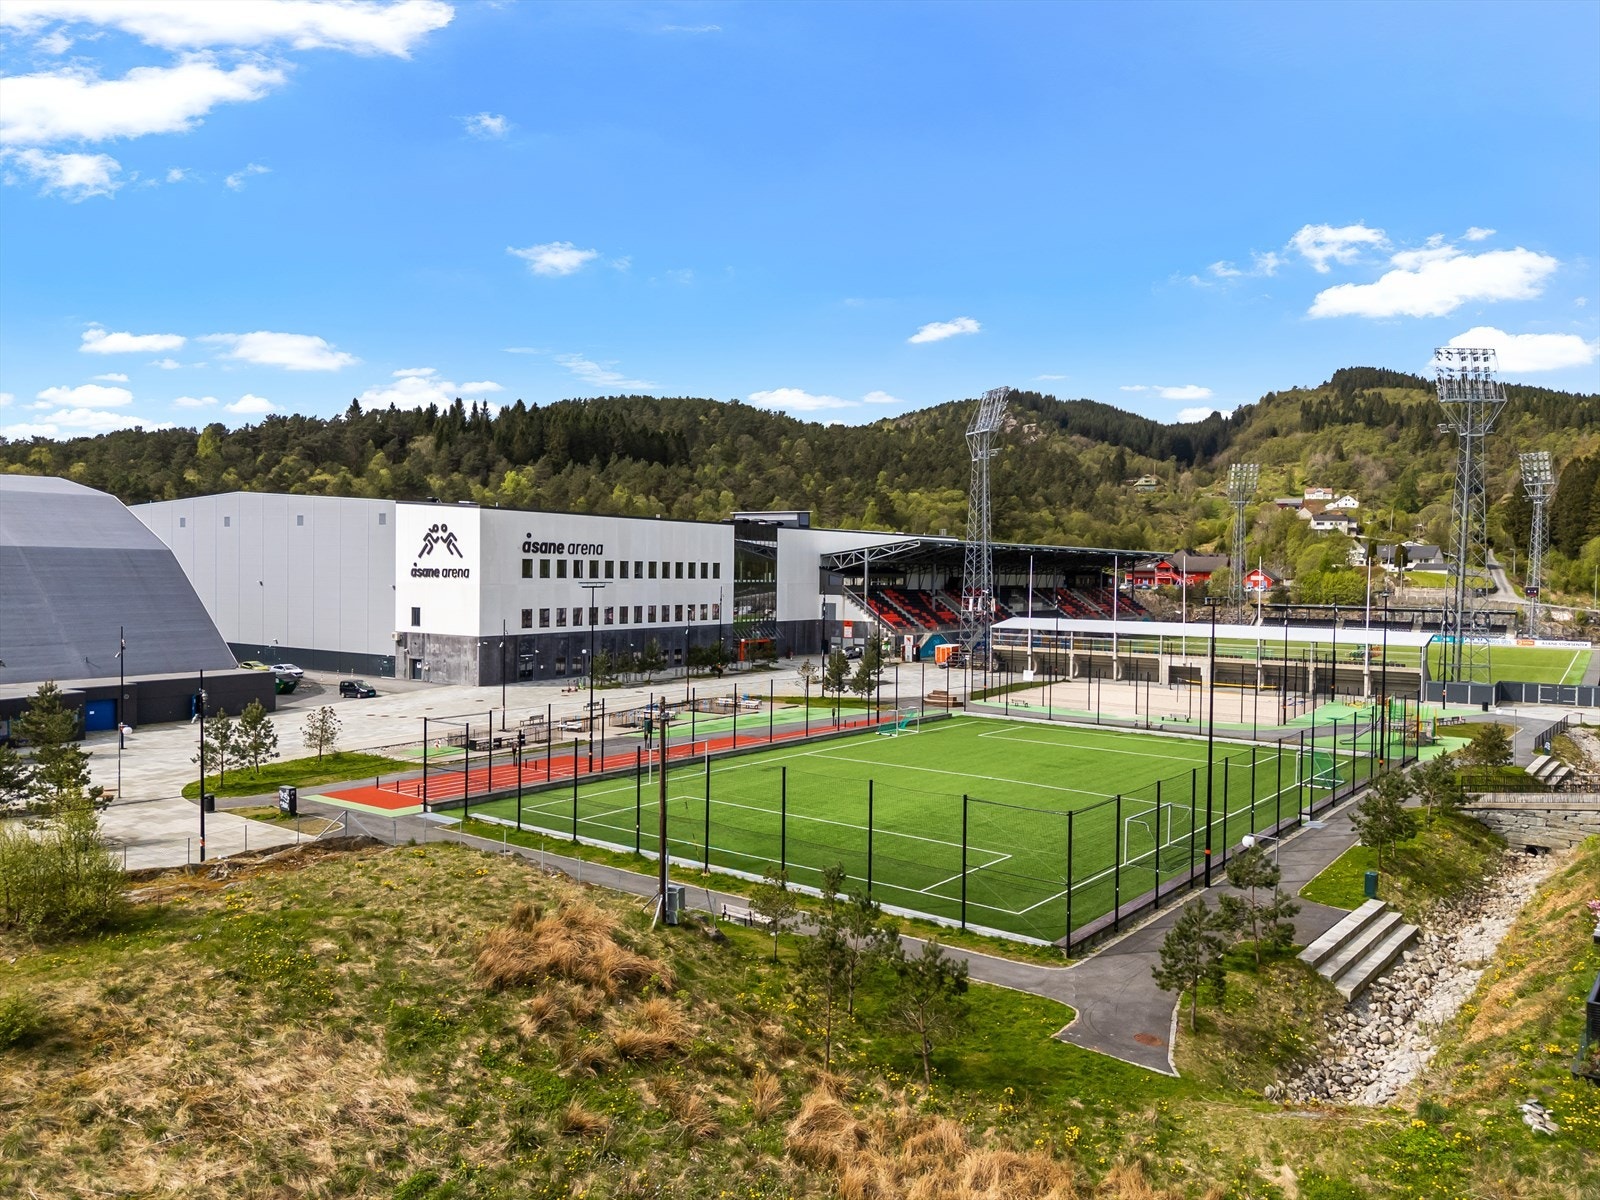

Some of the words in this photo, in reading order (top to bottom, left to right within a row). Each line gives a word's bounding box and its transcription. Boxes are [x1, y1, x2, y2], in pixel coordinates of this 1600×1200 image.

[522, 532, 565, 554] åsane
[567, 542, 604, 556] arena
[410, 562, 440, 578] åsane
[441, 568, 470, 578] arena
